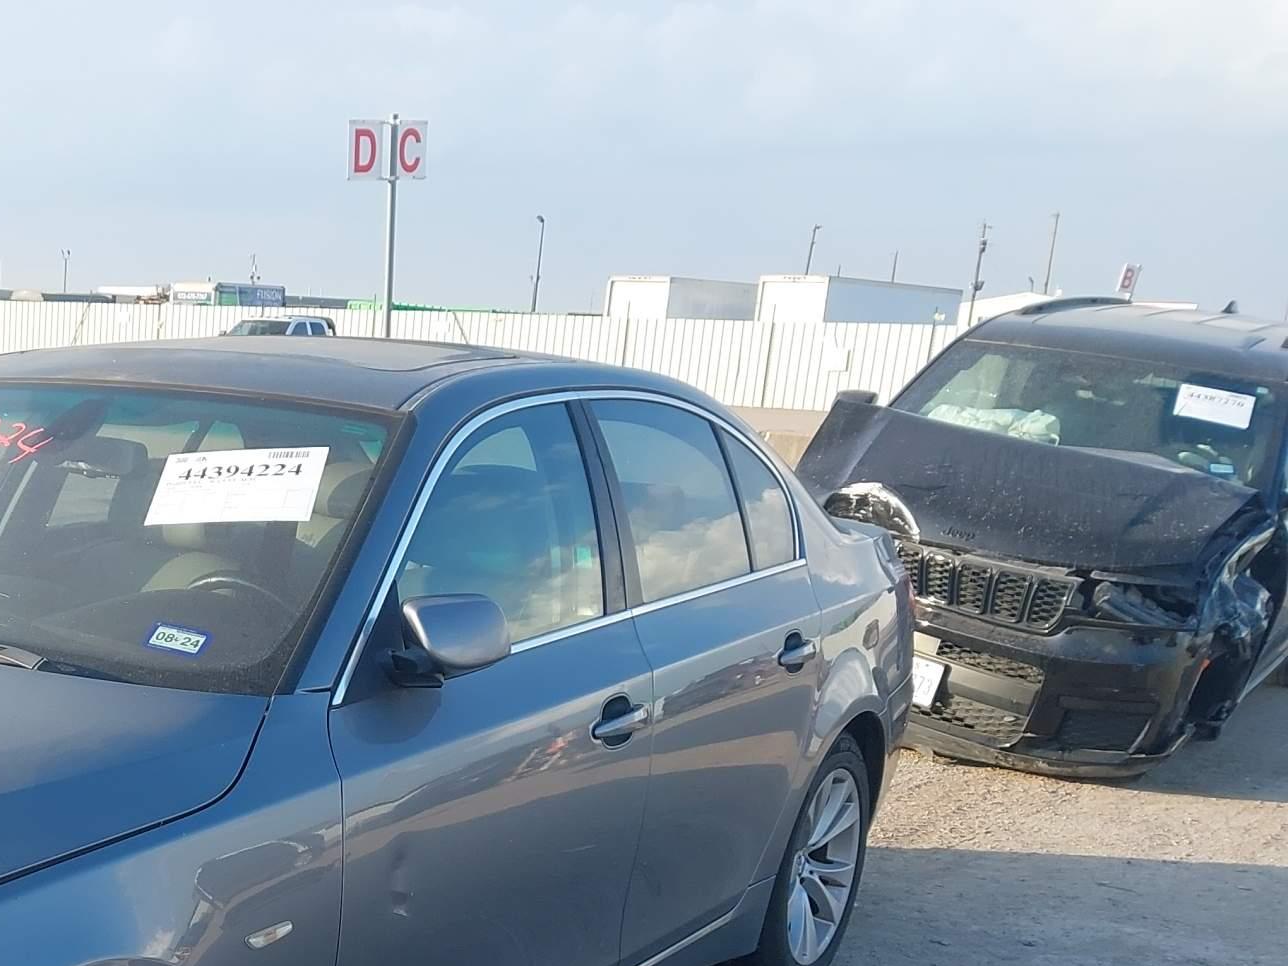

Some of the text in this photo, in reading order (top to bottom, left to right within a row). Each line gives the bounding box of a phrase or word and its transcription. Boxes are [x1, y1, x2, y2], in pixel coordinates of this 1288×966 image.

[353, 127, 377, 173] D
[399, 127, 422, 173] C
[178, 463, 303, 480] 44394224
[179, 636, 200, 649] 24
